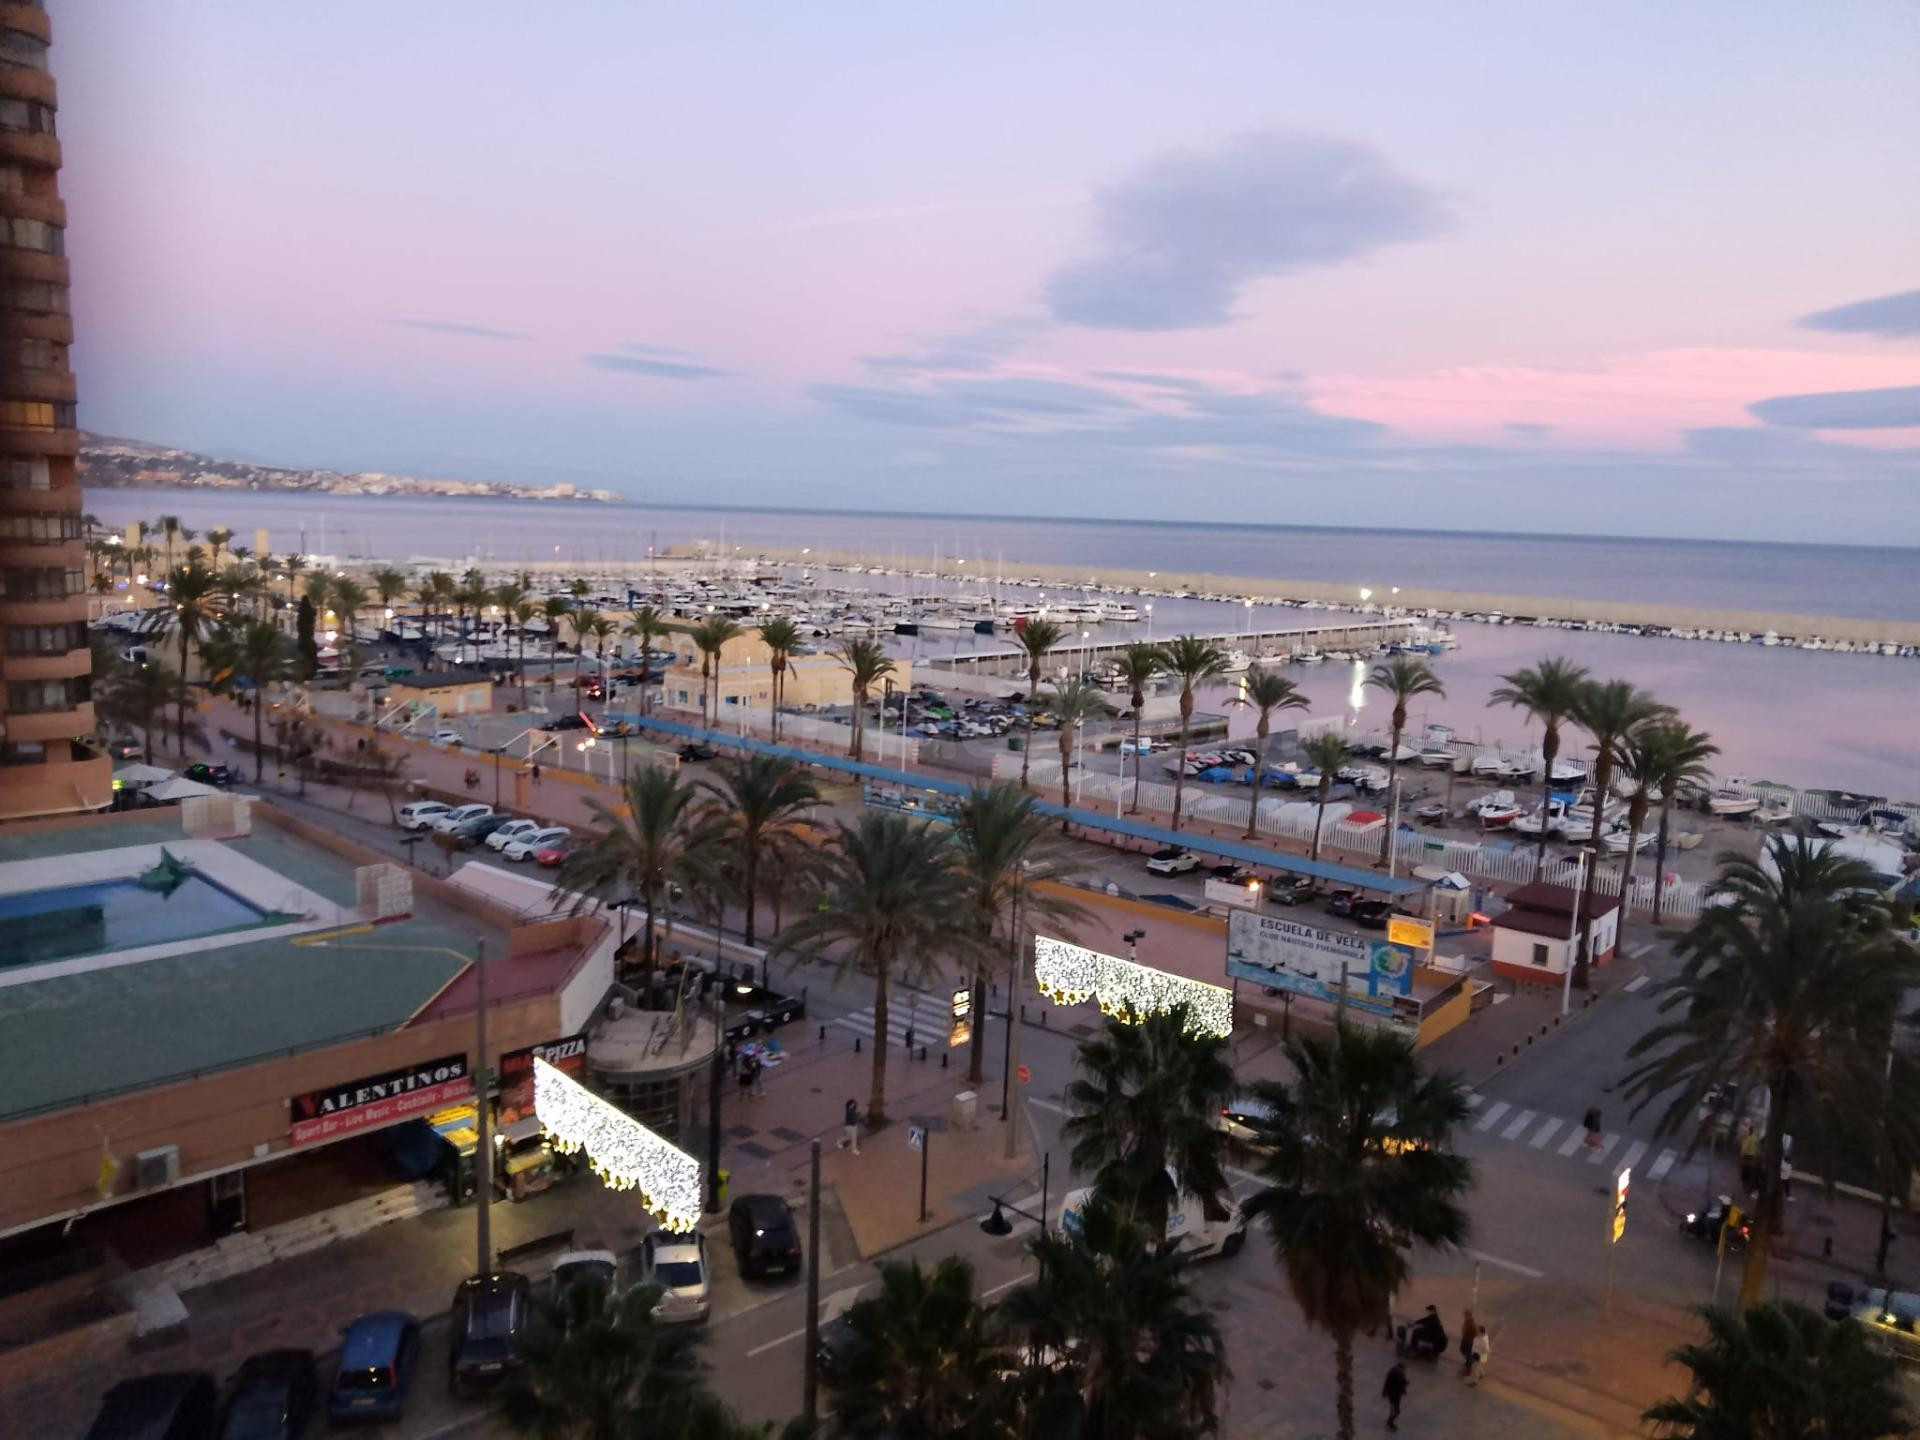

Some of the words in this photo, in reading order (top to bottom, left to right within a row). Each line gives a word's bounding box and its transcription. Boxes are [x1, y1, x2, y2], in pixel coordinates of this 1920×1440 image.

[1259, 931, 1279, 941] CLUB
[1316, 943, 1366, 960] FUENGIROLA
[1260, 918, 1312, 938] ESCUELA
[1316, 930, 1332, 942] DE
[1336, 935, 1366, 951] VELA
[545, 1039, 586, 1064] PIZZA
[299, 1064, 462, 1115] VALENTINOS
[296, 1124, 320, 1142] Sport
[322, 1120, 338, 1133] Bar
[345, 1114, 364, 1127] Live
[366, 1105, 390, 1122] Music
[397, 1093, 436, 1112] Cocktails
